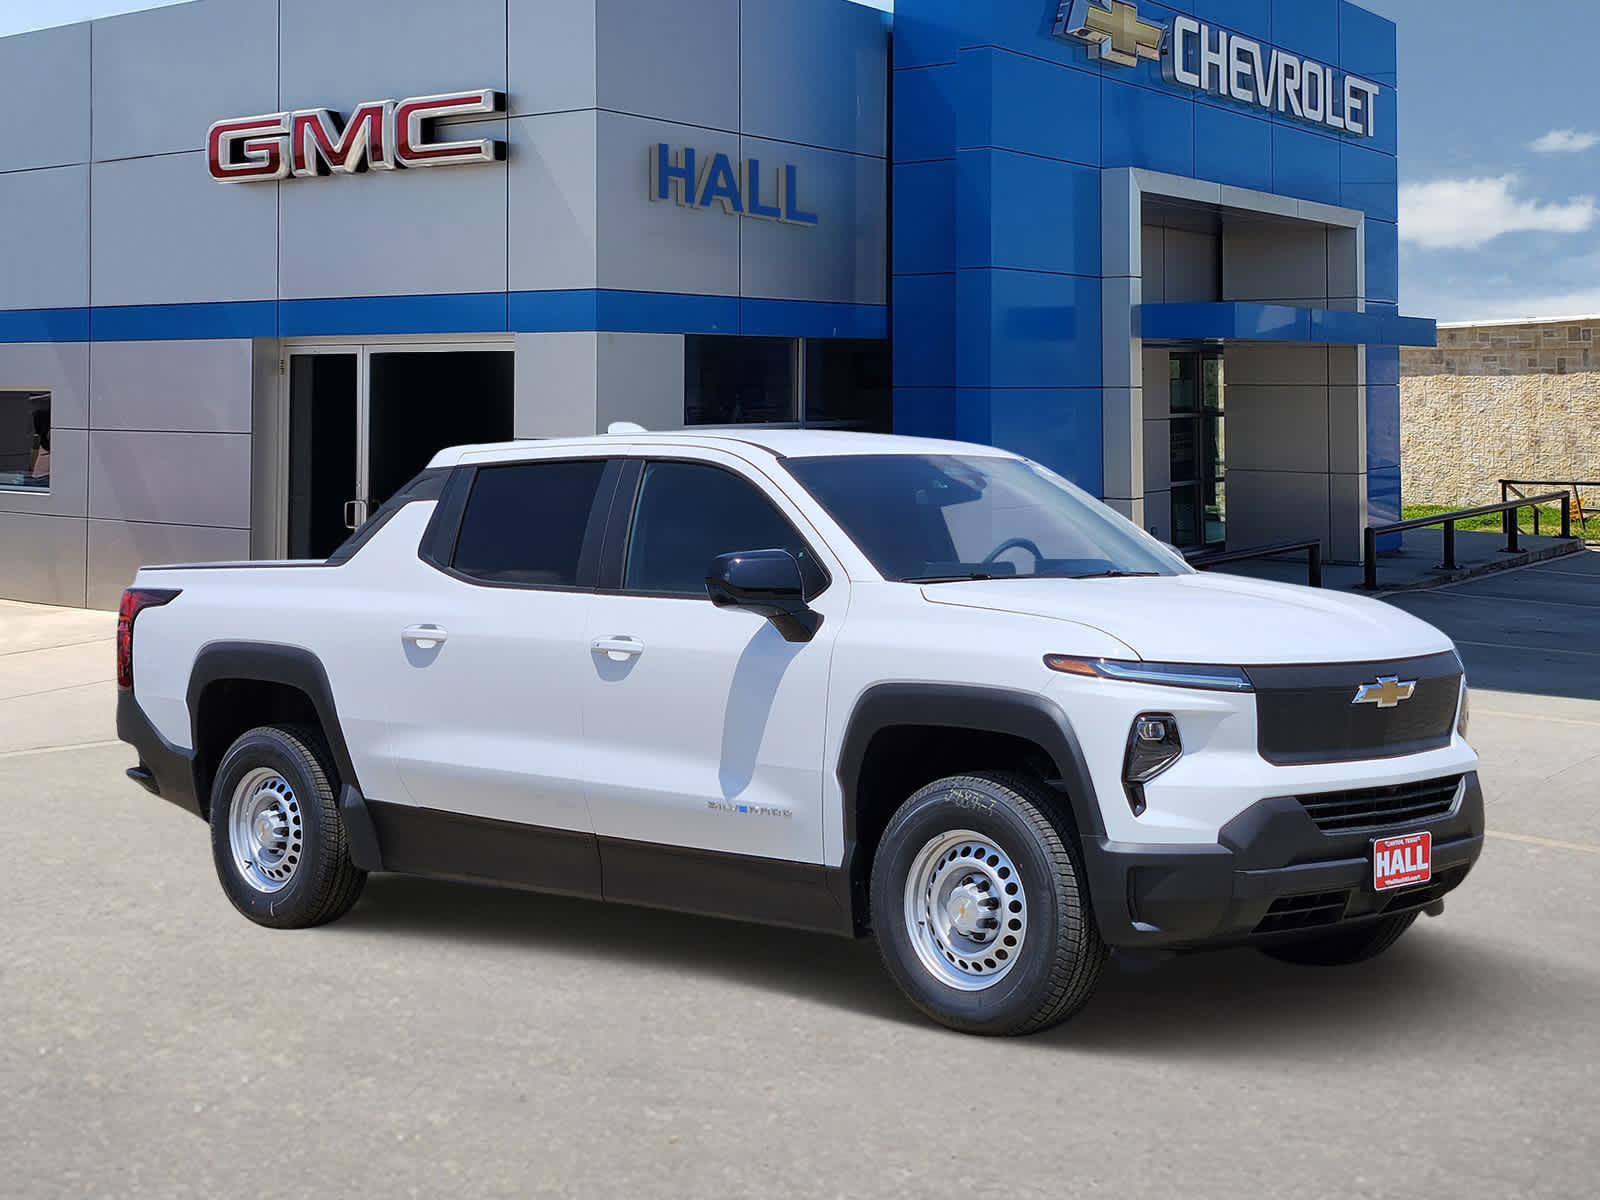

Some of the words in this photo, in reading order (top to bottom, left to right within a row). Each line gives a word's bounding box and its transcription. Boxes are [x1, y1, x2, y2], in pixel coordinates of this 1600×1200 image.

[1173, 15, 1380, 137] CHEVROLET
[205, 88, 507, 184] GMC
[651, 143, 818, 226] HALL
[1376, 845, 1429, 878] HALL
